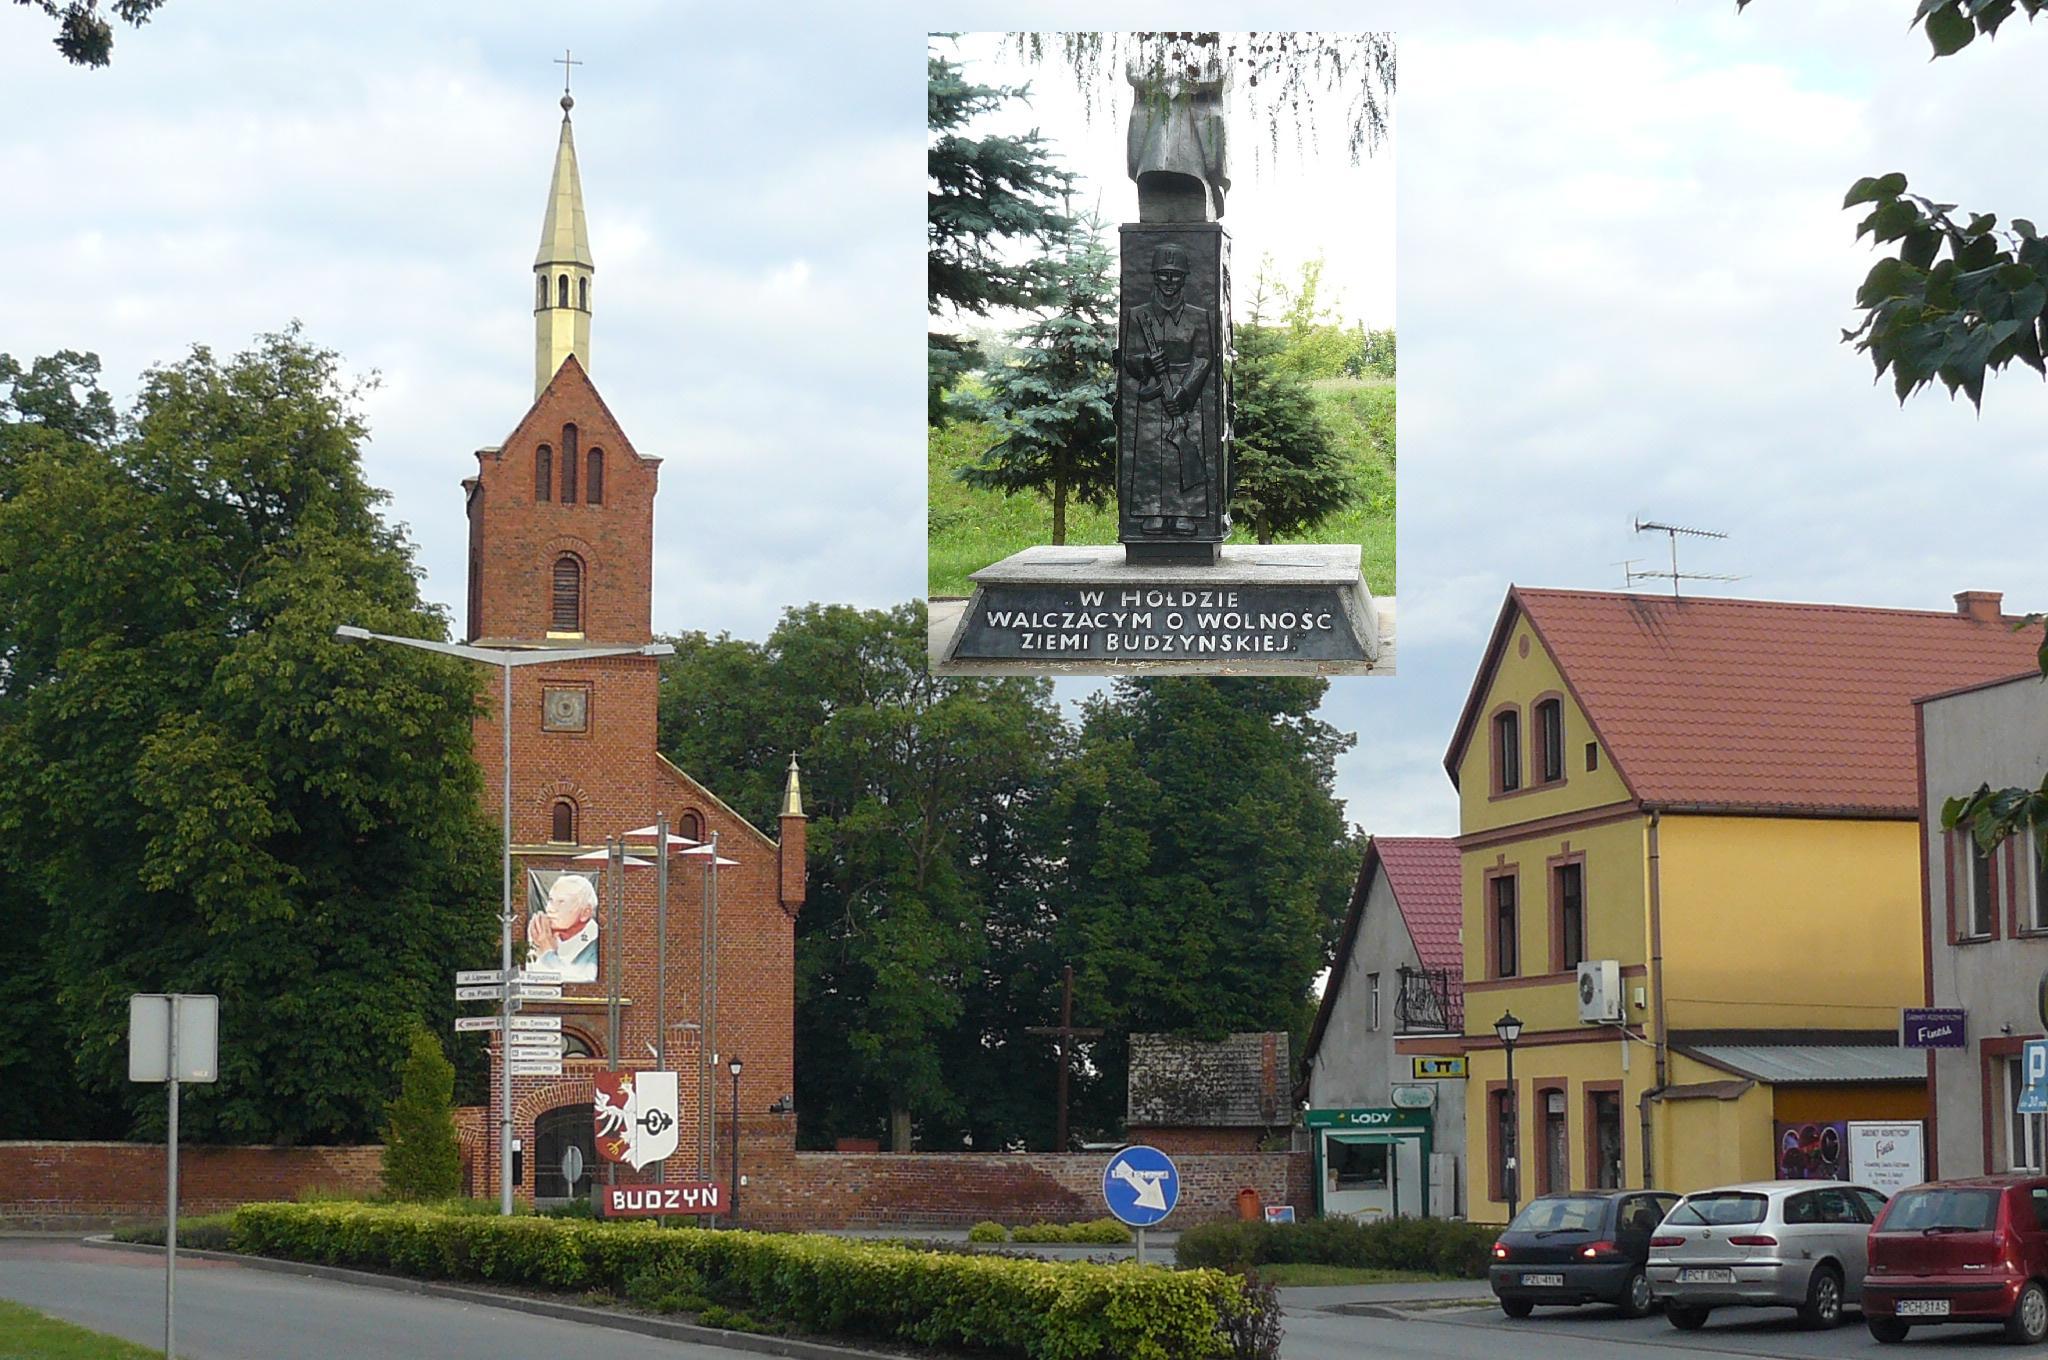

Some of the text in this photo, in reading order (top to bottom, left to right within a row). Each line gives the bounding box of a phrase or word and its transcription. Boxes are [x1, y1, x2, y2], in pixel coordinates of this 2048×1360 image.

[1120, 589, 1239, 608] HOŁDZIE
[1166, 612, 1184, 630] O
[1196, 607, 1332, 630] WOLNOŚĆ
[1021, 633, 1089, 650] ZIEMI
[1421, 1060, 1461, 1073] LOTTO
[2029, 1046, 2046, 1091] P
[1350, 1112, 1392, 1124] LODY
[612, 1183, 718, 1210] BUDZYŃ
[1902, 1301, 1921, 1313] PCH
